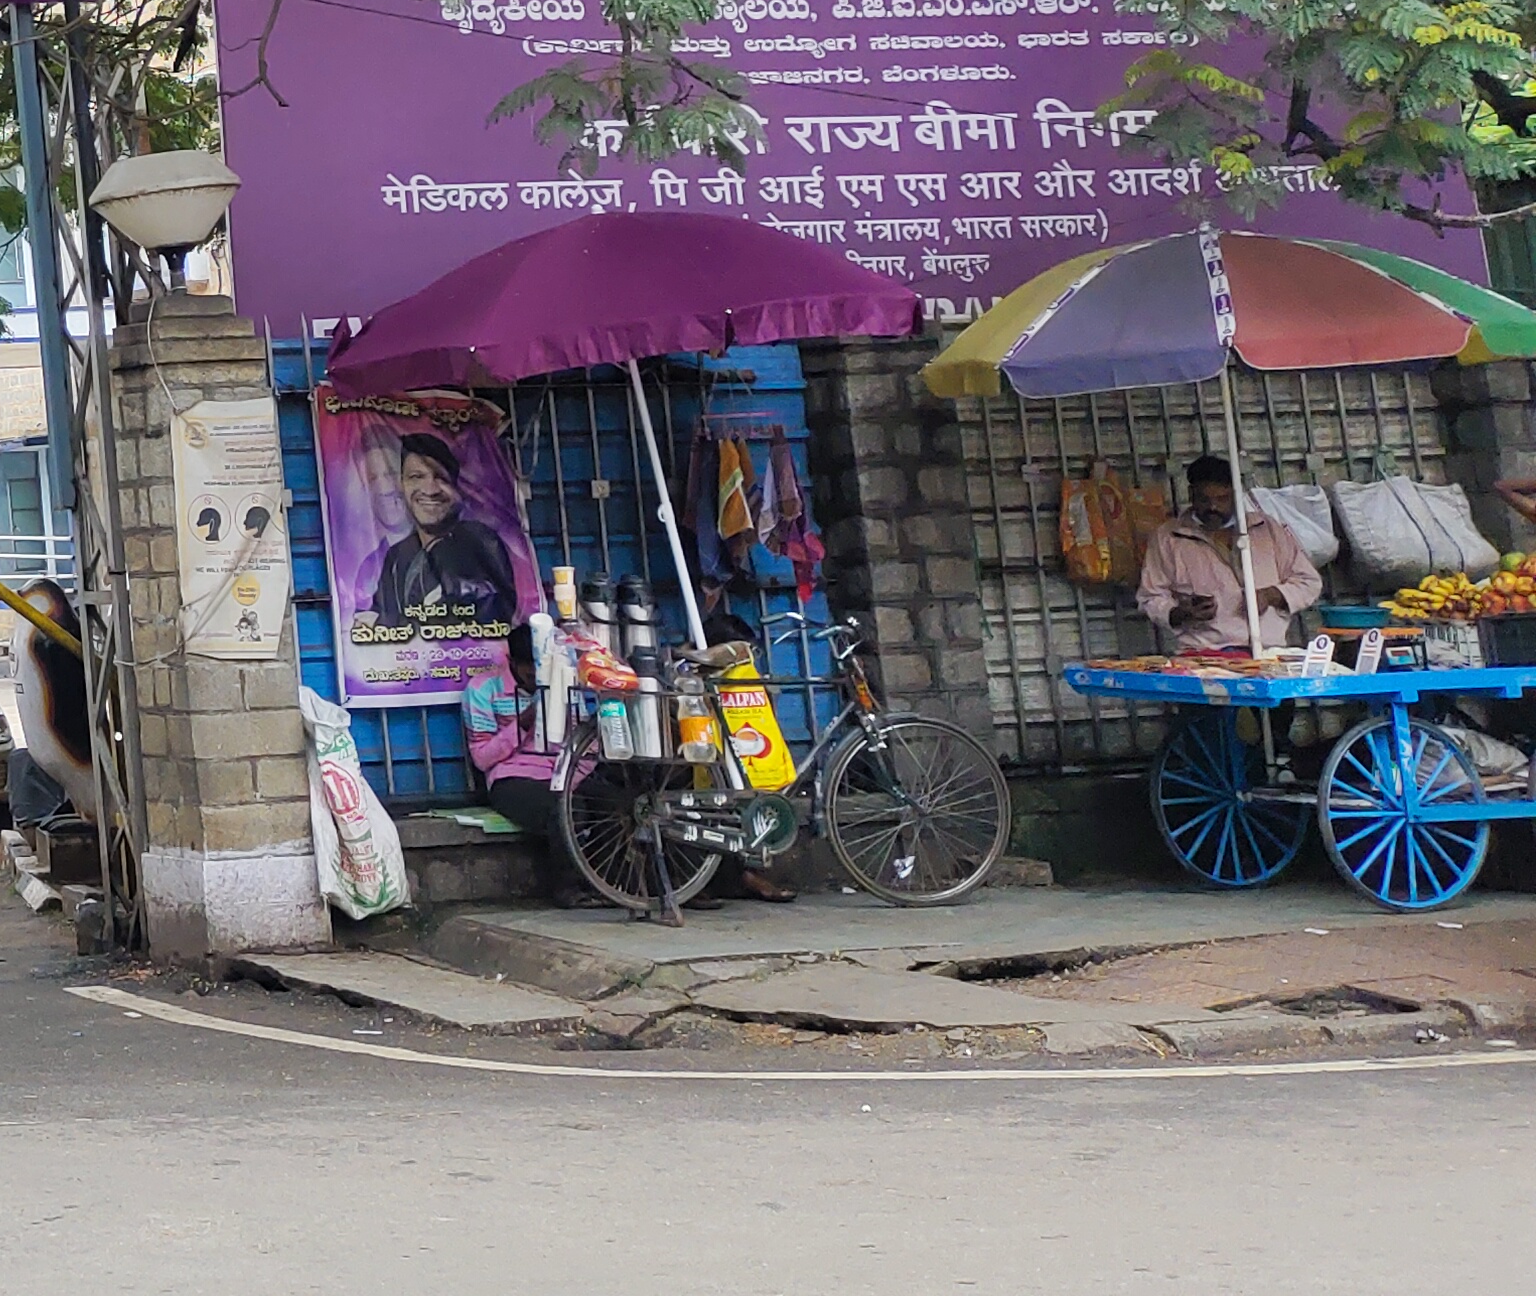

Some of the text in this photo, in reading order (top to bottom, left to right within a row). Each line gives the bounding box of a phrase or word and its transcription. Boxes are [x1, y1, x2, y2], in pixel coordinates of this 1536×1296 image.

[743, 34, 857, 59] ಉದ್ಯೋಗ
[1017, 29, 1090, 49] ಭಾರತ
[783, 115, 903, 155] राज्य
[909, 100, 1018, 151] बीमा
[380, 173, 510, 214] मेडिकल
[648, 168, 689, 207] पि
[697, 166, 746, 205] जी
[758, 165, 825, 209] आई
[835, 174, 885, 209] एम
[894, 173, 948, 207] एस
[960, 171, 1022, 200] आर
[1034, 158, 1096, 198] और
[1107, 158, 1202, 196] आदर्श
[351, 622, 414, 643] ಪುನೀತ್
